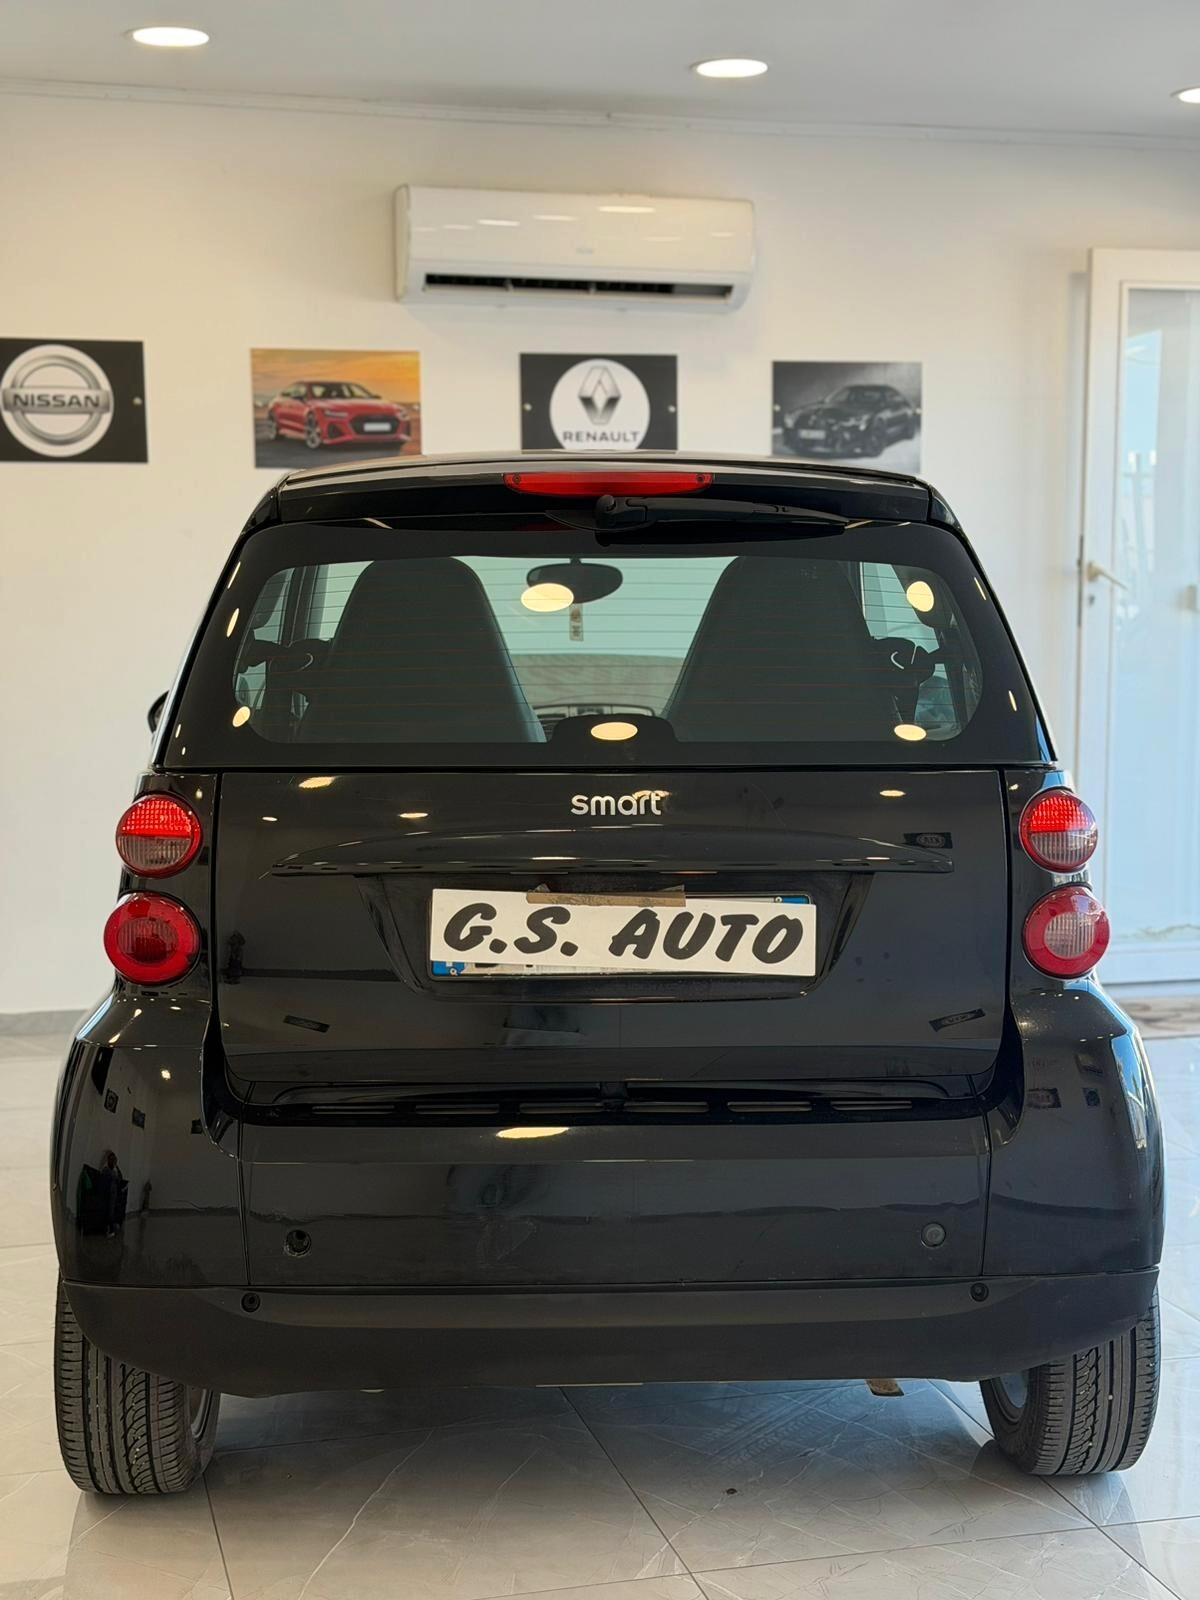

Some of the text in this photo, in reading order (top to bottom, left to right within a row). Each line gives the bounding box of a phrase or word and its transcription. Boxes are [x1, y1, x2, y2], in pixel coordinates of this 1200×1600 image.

[13, 393, 100, 408] NISSAN
[562, 430, 640, 443] RENAULT
[571, 793, 662, 816] smart
[443, 902, 804, 965] G.S. AUTO
